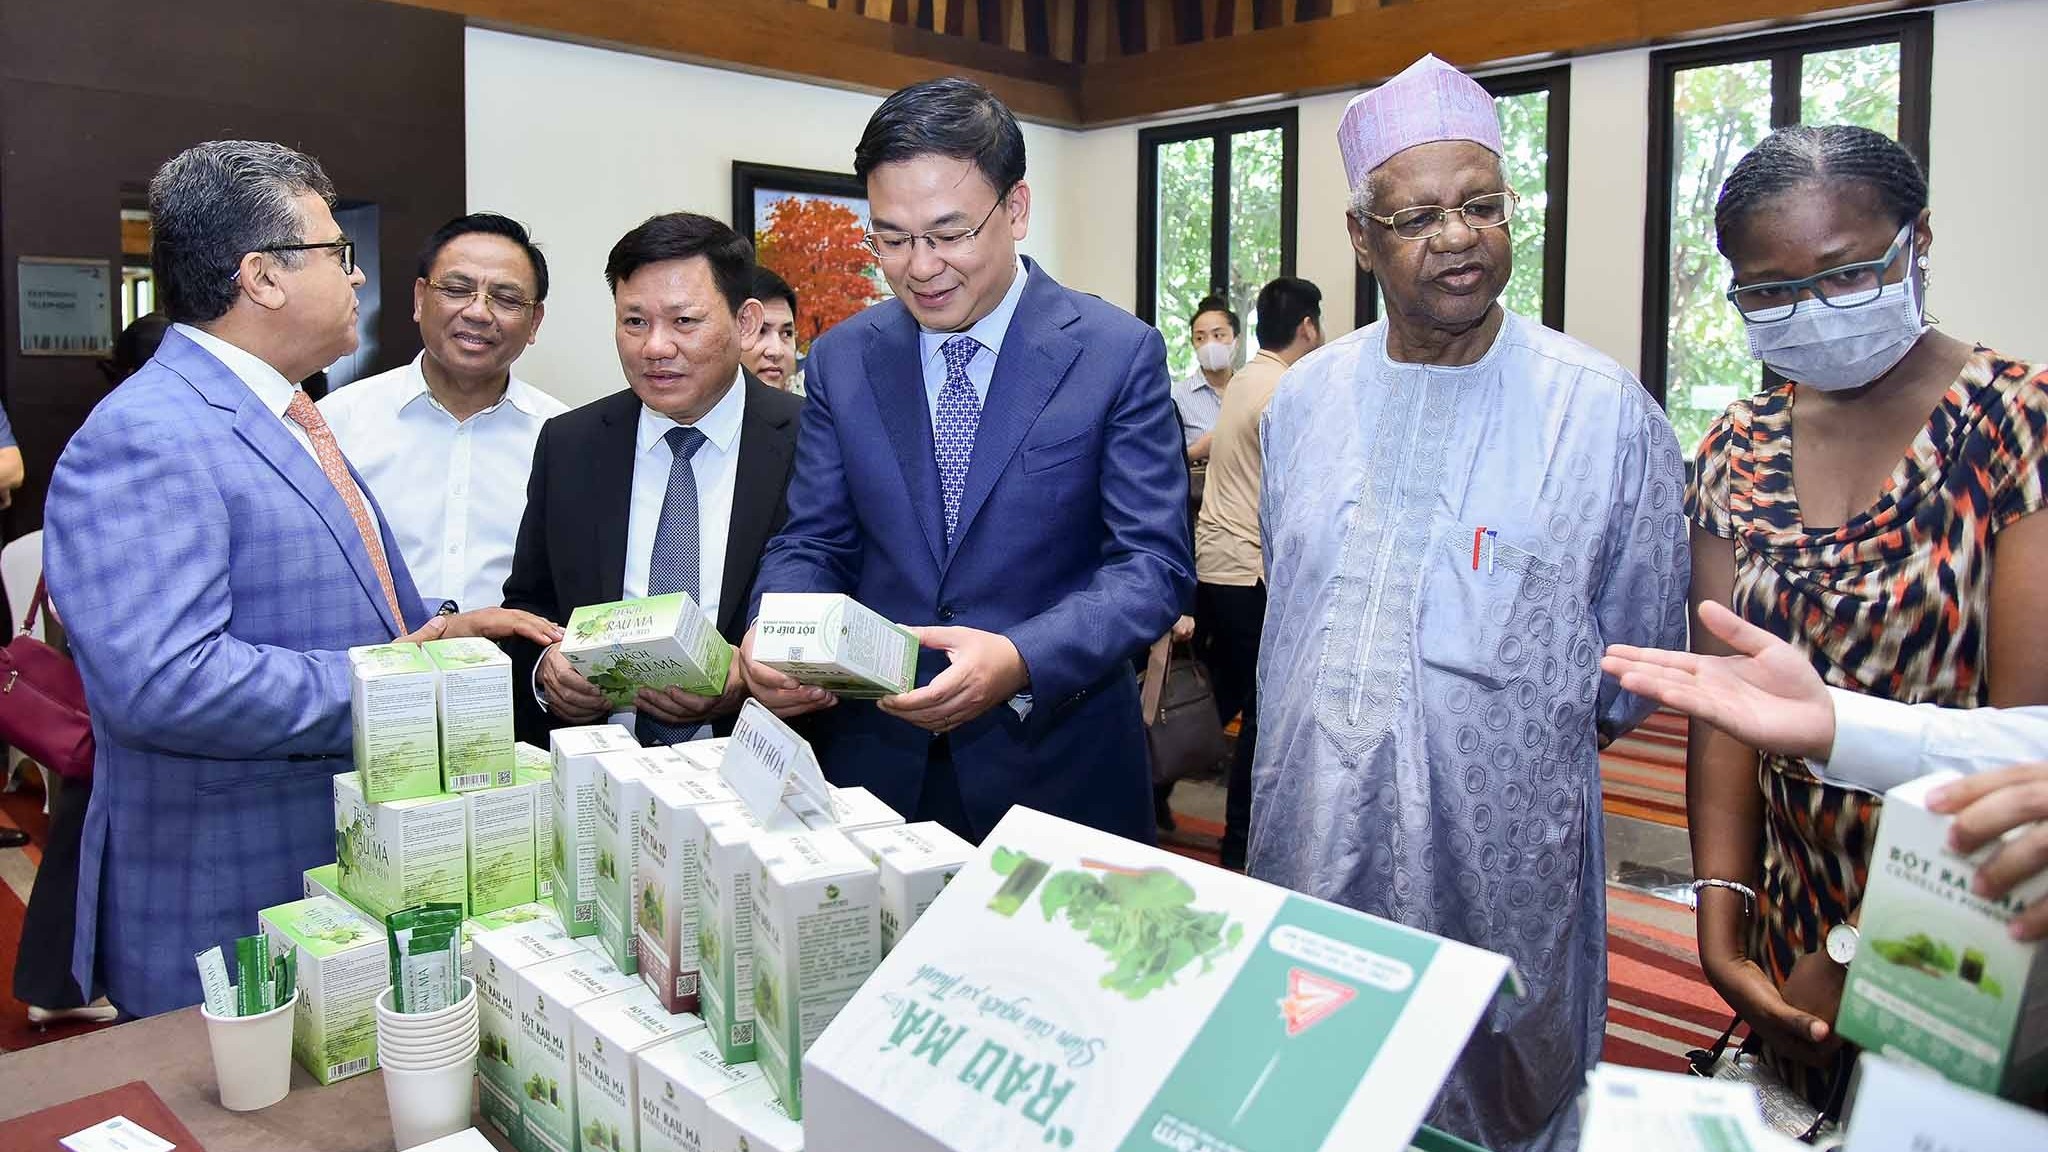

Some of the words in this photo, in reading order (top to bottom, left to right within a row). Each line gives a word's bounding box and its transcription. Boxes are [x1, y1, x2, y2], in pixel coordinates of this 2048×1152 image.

[536, 1021, 552, 1042] RAU
[879, 999, 970, 1068] MÁ
[594, 1064, 610, 1086] RAU
[957, 1037, 1076, 1127] RAU
[662, 1111, 683, 1135] RAU
